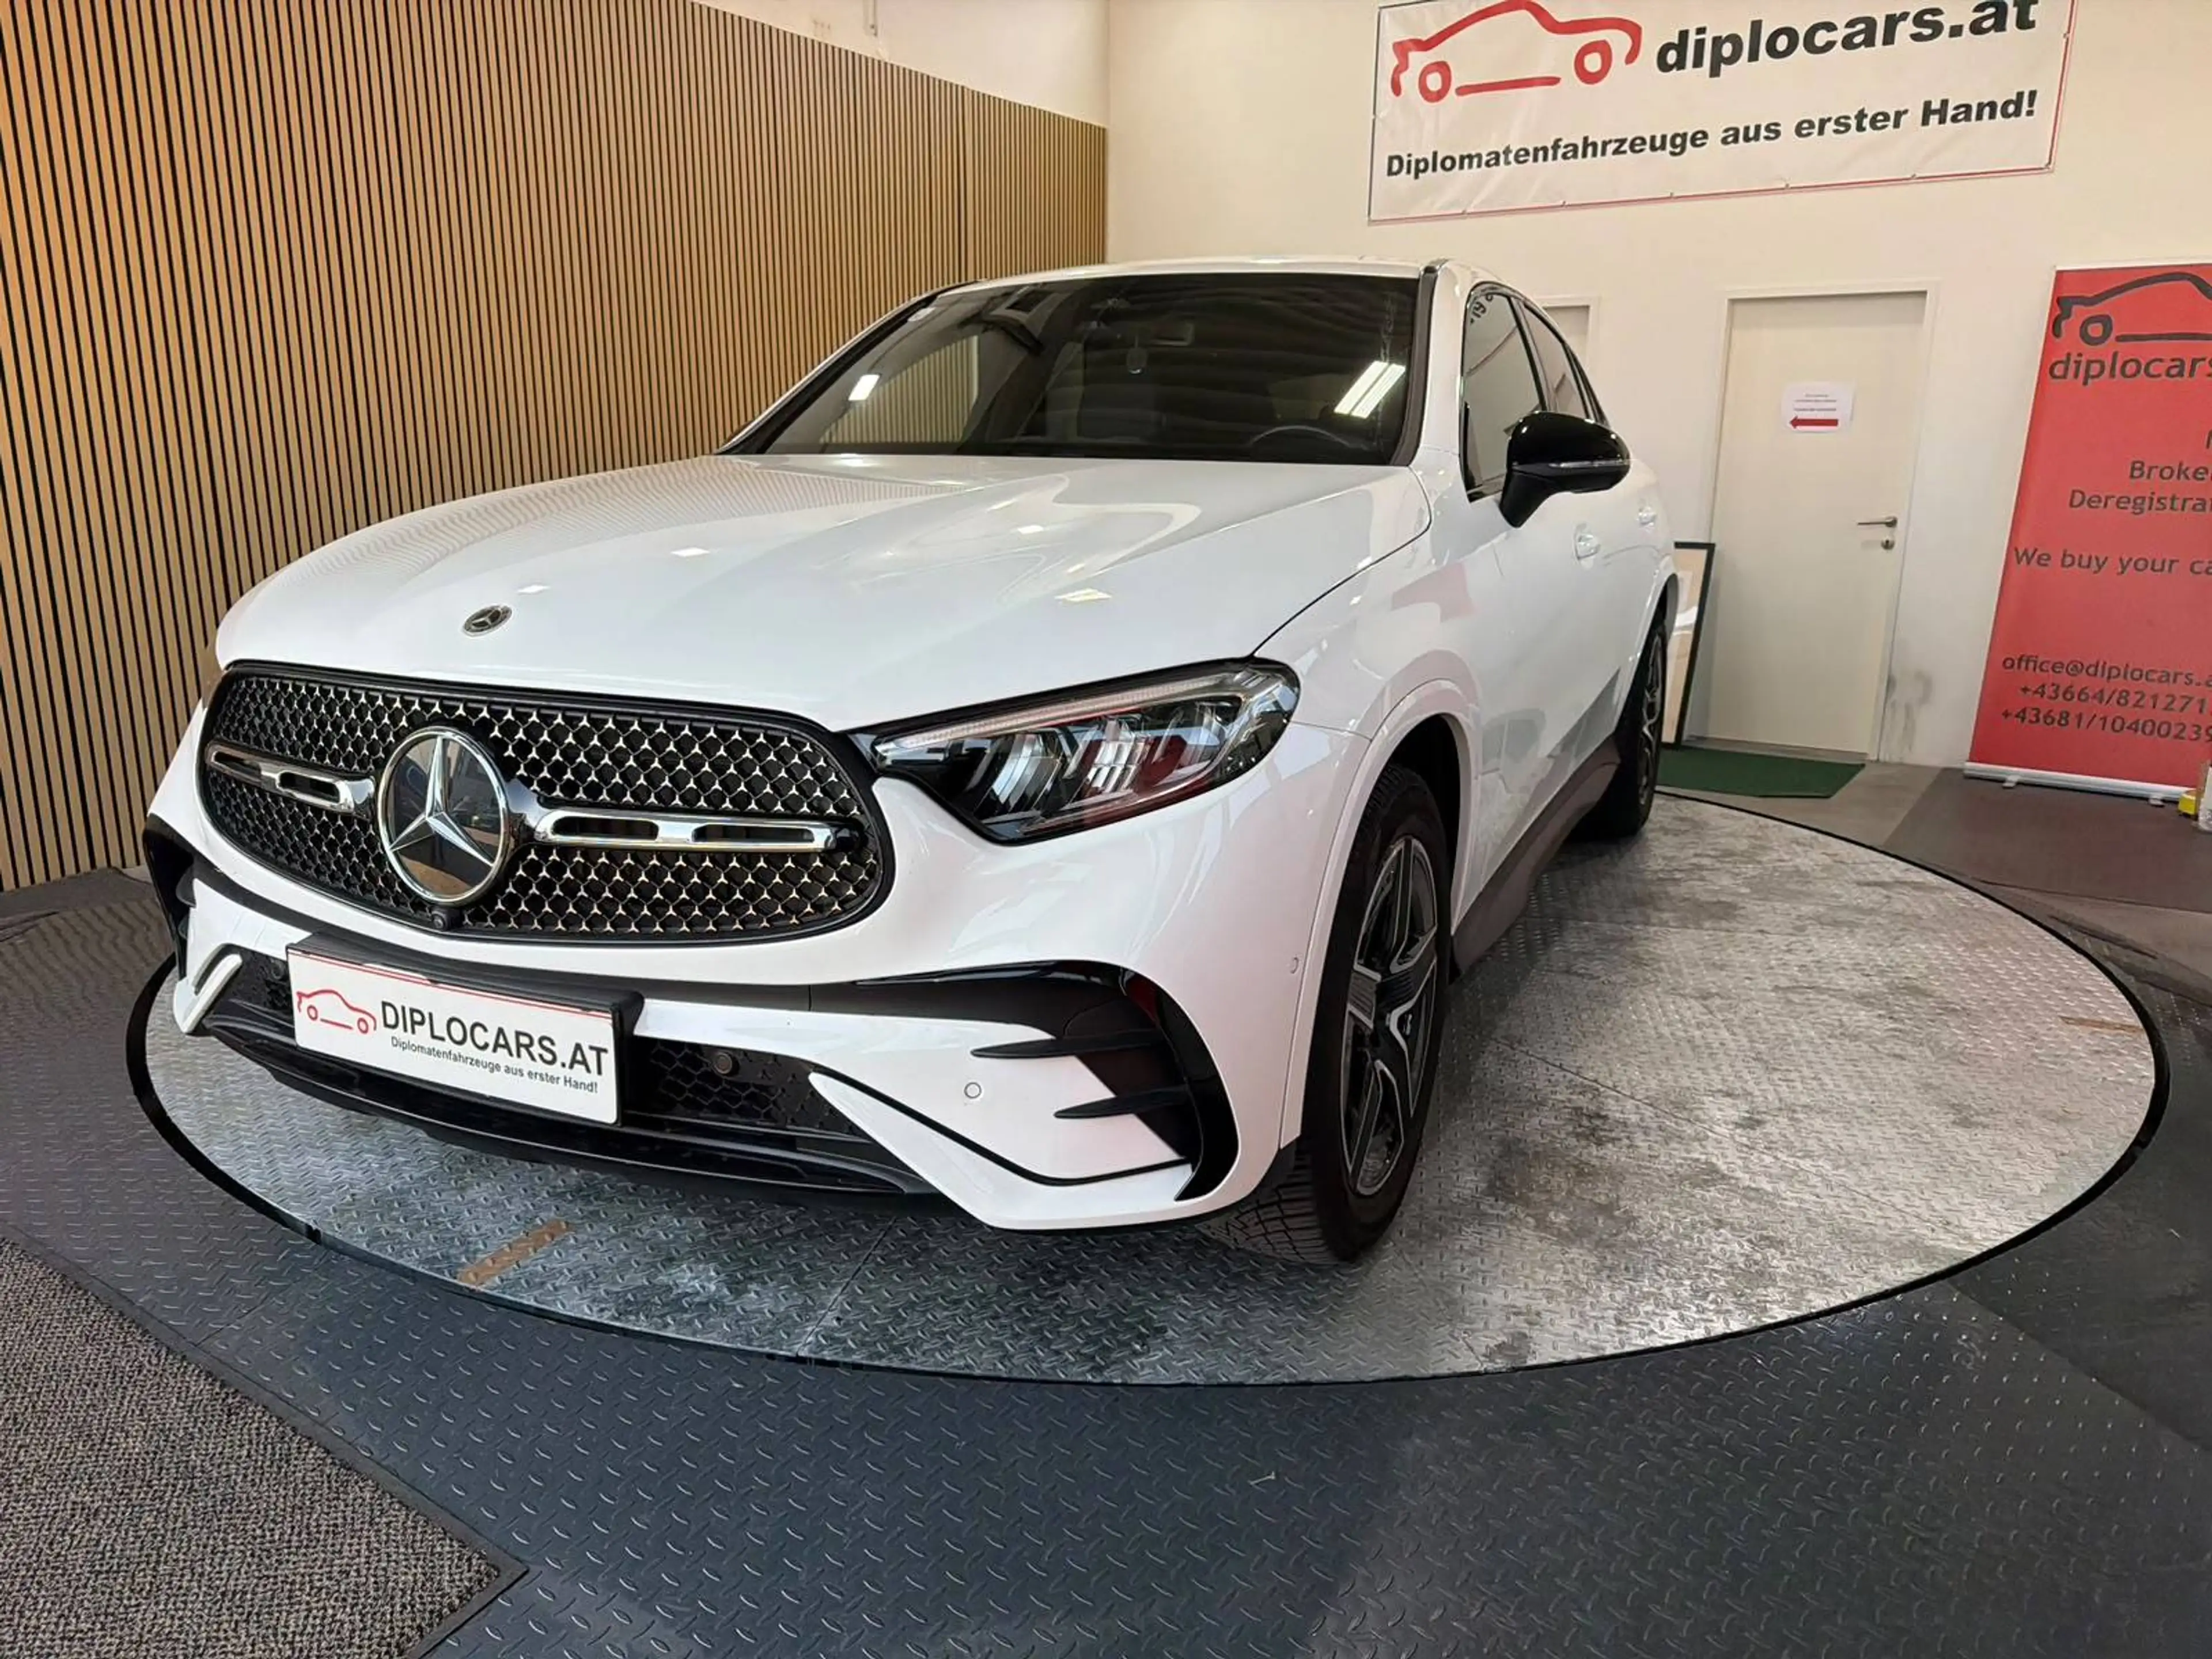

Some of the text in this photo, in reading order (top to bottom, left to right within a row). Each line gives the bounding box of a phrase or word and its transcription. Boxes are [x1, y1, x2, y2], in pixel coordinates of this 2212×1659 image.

[1657, 0, 2038, 78] diplocars.at
[1387, 89, 2037, 180] Diplomatenfahrzeuge aus erster Hand!
[2129, 460, 2212, 481] Broke
[2069, 489, 2212, 514] Deregistra
[2014, 547, 2052, 567] We
[2061, 549, 2108, 574] buy
[2118, 556, 2179, 575] your
[2020, 683, 2212, 714] +43664/821271
[381, 1001, 608, 1076] DIPLOCARS.AT
[391, 1036, 599, 1093] Diplomatenfahrzeuge aus erster Hand!
